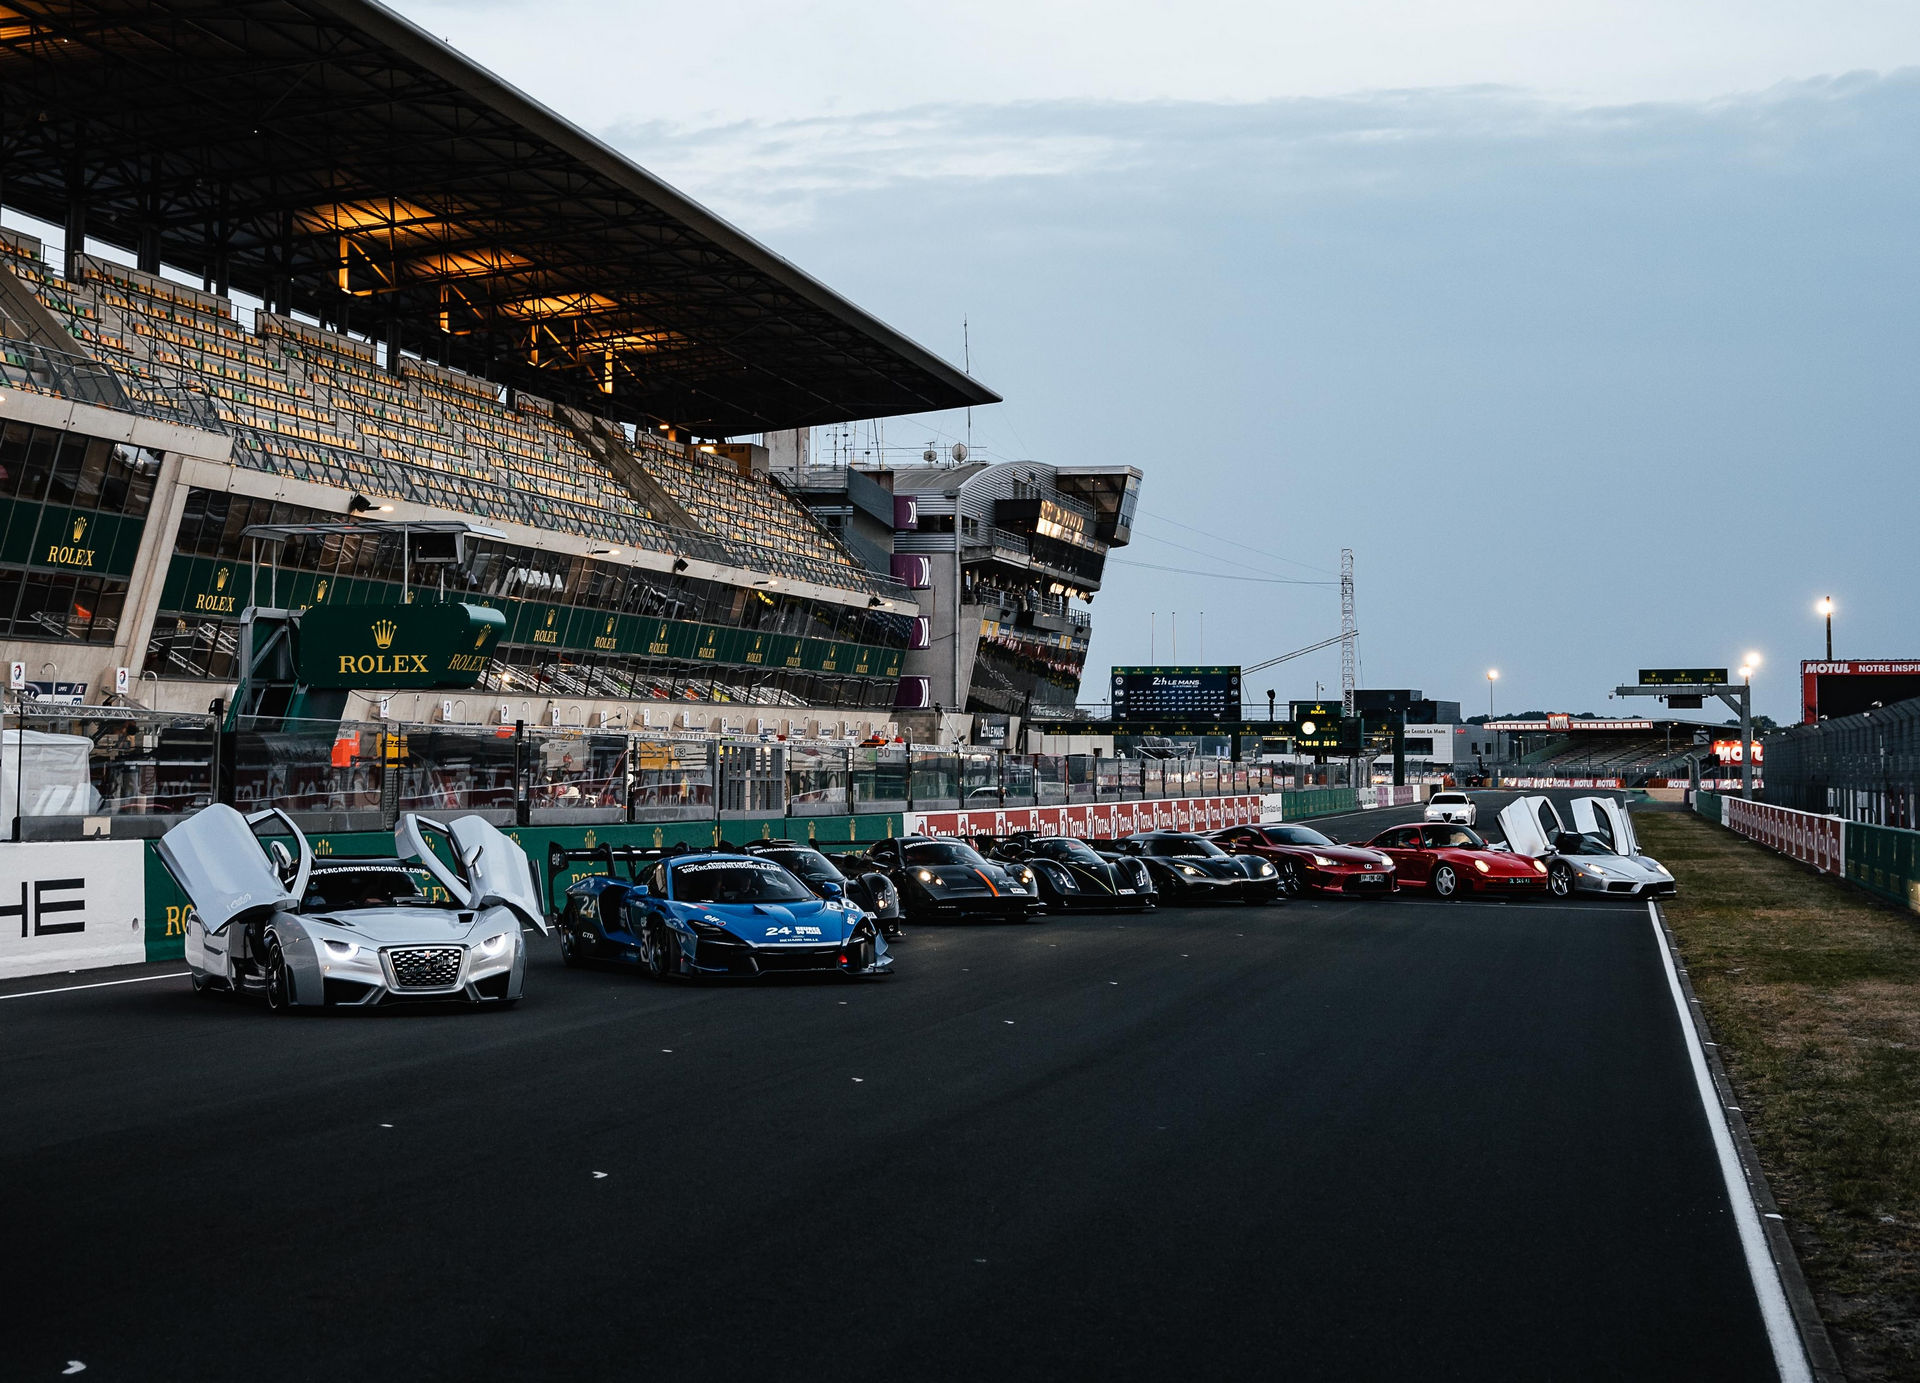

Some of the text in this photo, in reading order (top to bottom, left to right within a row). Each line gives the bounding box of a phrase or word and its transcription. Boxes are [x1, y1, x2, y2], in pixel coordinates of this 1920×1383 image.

[47, 546, 96, 567] ROLEX
[196, 594, 235, 612] ROLEX
[534, 630, 558, 644] ROLEX
[594, 636, 617, 650] ROLEX
[648, 642, 669, 654] ROLEX
[698, 648, 716, 659] ROLEX
[338, 654, 429, 674] ROLEX
[448, 653, 487, 672] ROLEX
[746, 652, 762, 664] ROLEX
[1805, 664, 1850, 674] MOTUL
[1858, 664, 1890, 672] NOTRE
[1550, 716, 1569, 729] MOTUL
[1596, 780, 1616, 788] MOTUL
[1040, 820, 1059, 837] TOTAL
[1069, 817, 1086, 837] TOTAL
[1095, 815, 1110, 834] TOTAL
[1118, 814, 1133, 832] TOTAL
[1140, 812, 1153, 829] TOTAL
[580, 896, 596, 918] 24
[766, 926, 792, 936] 24
